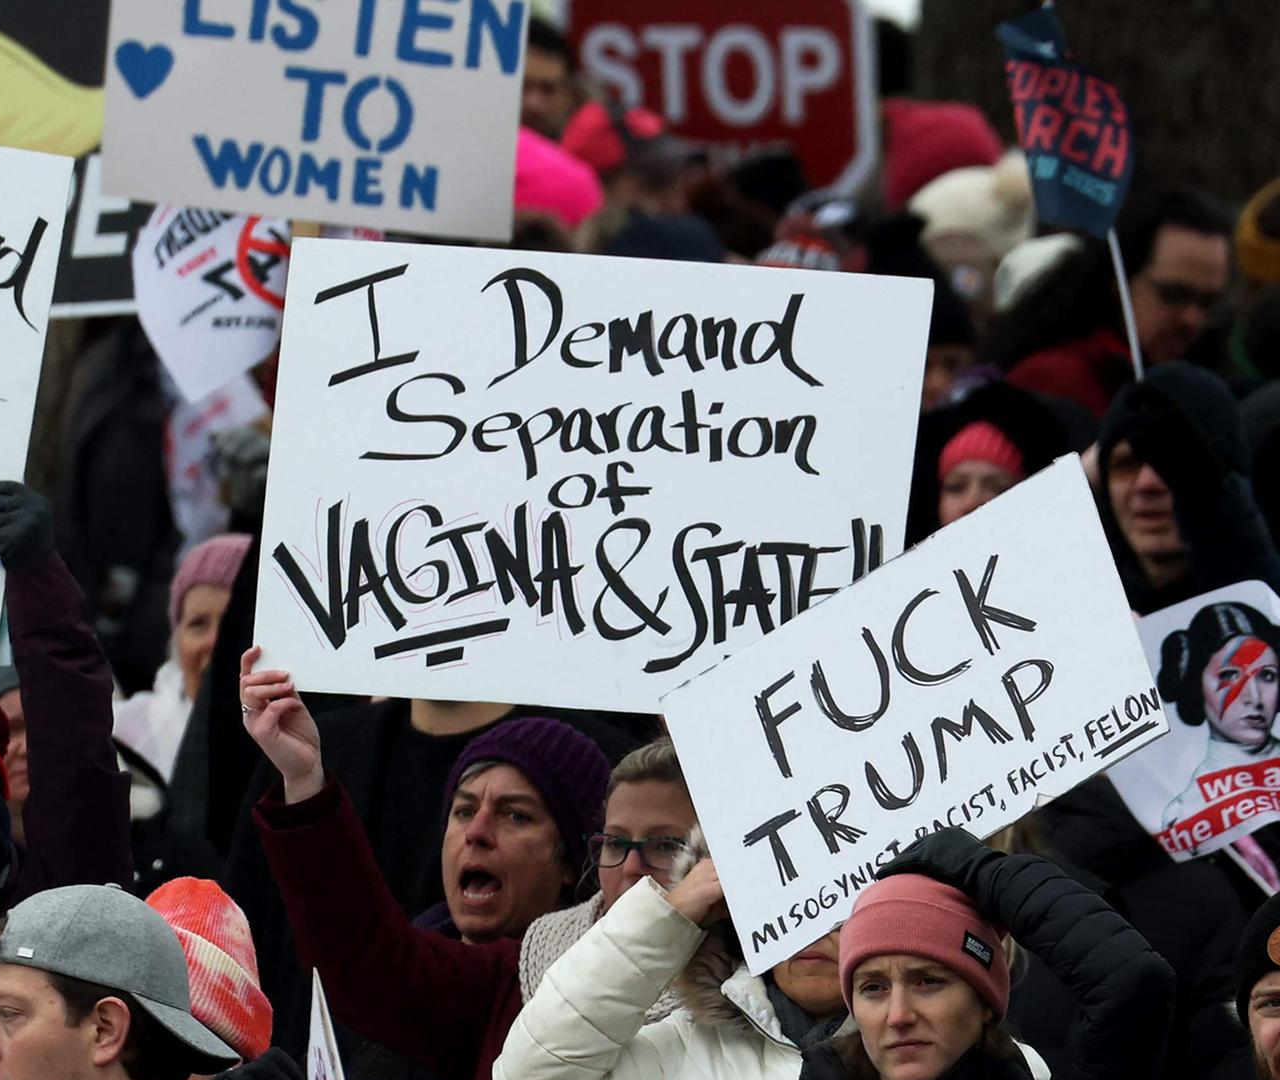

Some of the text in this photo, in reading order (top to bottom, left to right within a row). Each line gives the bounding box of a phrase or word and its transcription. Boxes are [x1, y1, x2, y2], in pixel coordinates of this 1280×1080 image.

[183, 0, 519, 75] LISTEN
[579, 23, 841, 127] STOP
[285, 66, 414, 153] TO
[193, 134, 439, 212] WOMEN
[314, 263, 824, 390] I Demand
[358, 372, 820, 480] Separation
[548, 461, 653, 515] of
[272, 500, 587, 650] VAGINA
[593, 517, 672, 642] &
[754, 554, 1037, 779] FUCK
[1084, 686, 1160, 752] FELON
[743, 658, 1055, 887] TRUMP
[1202, 770, 1255, 800] we
[1157, 818, 1213, 853] the
